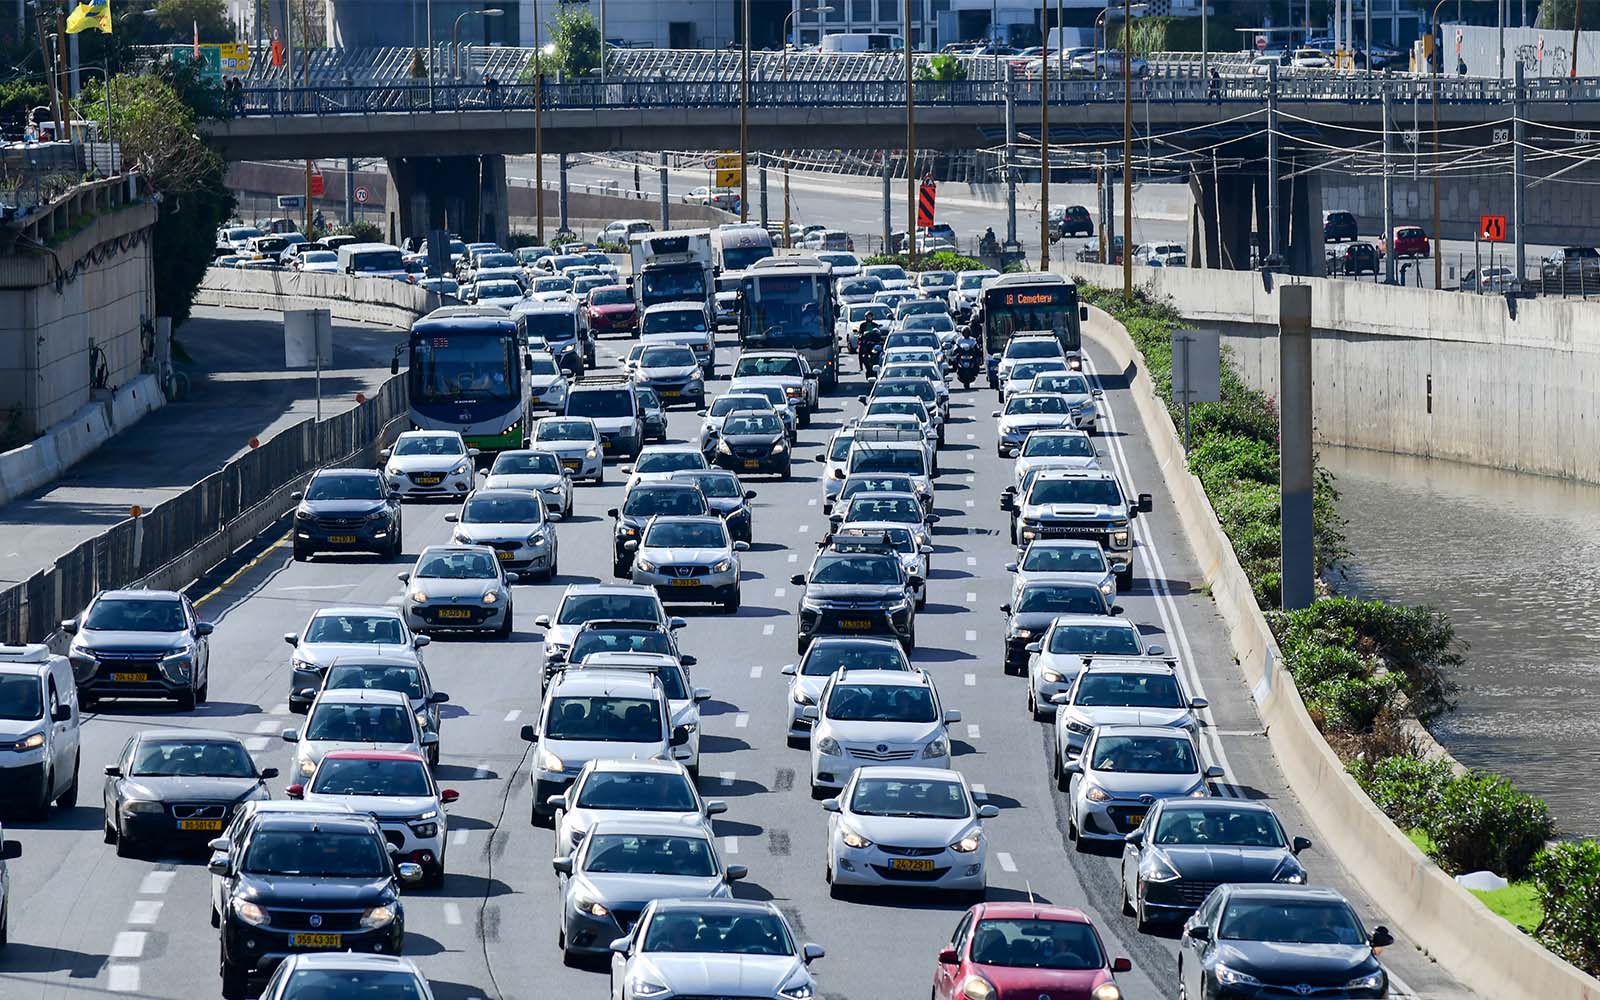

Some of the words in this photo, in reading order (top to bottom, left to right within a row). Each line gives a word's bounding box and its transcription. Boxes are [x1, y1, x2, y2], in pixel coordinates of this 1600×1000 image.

[1494, 131, 1508, 141] 5.6
[358, 191, 366, 199] 70
[1006, 294, 1014, 305] 18
[1017, 293, 1053, 305] Cemetery
